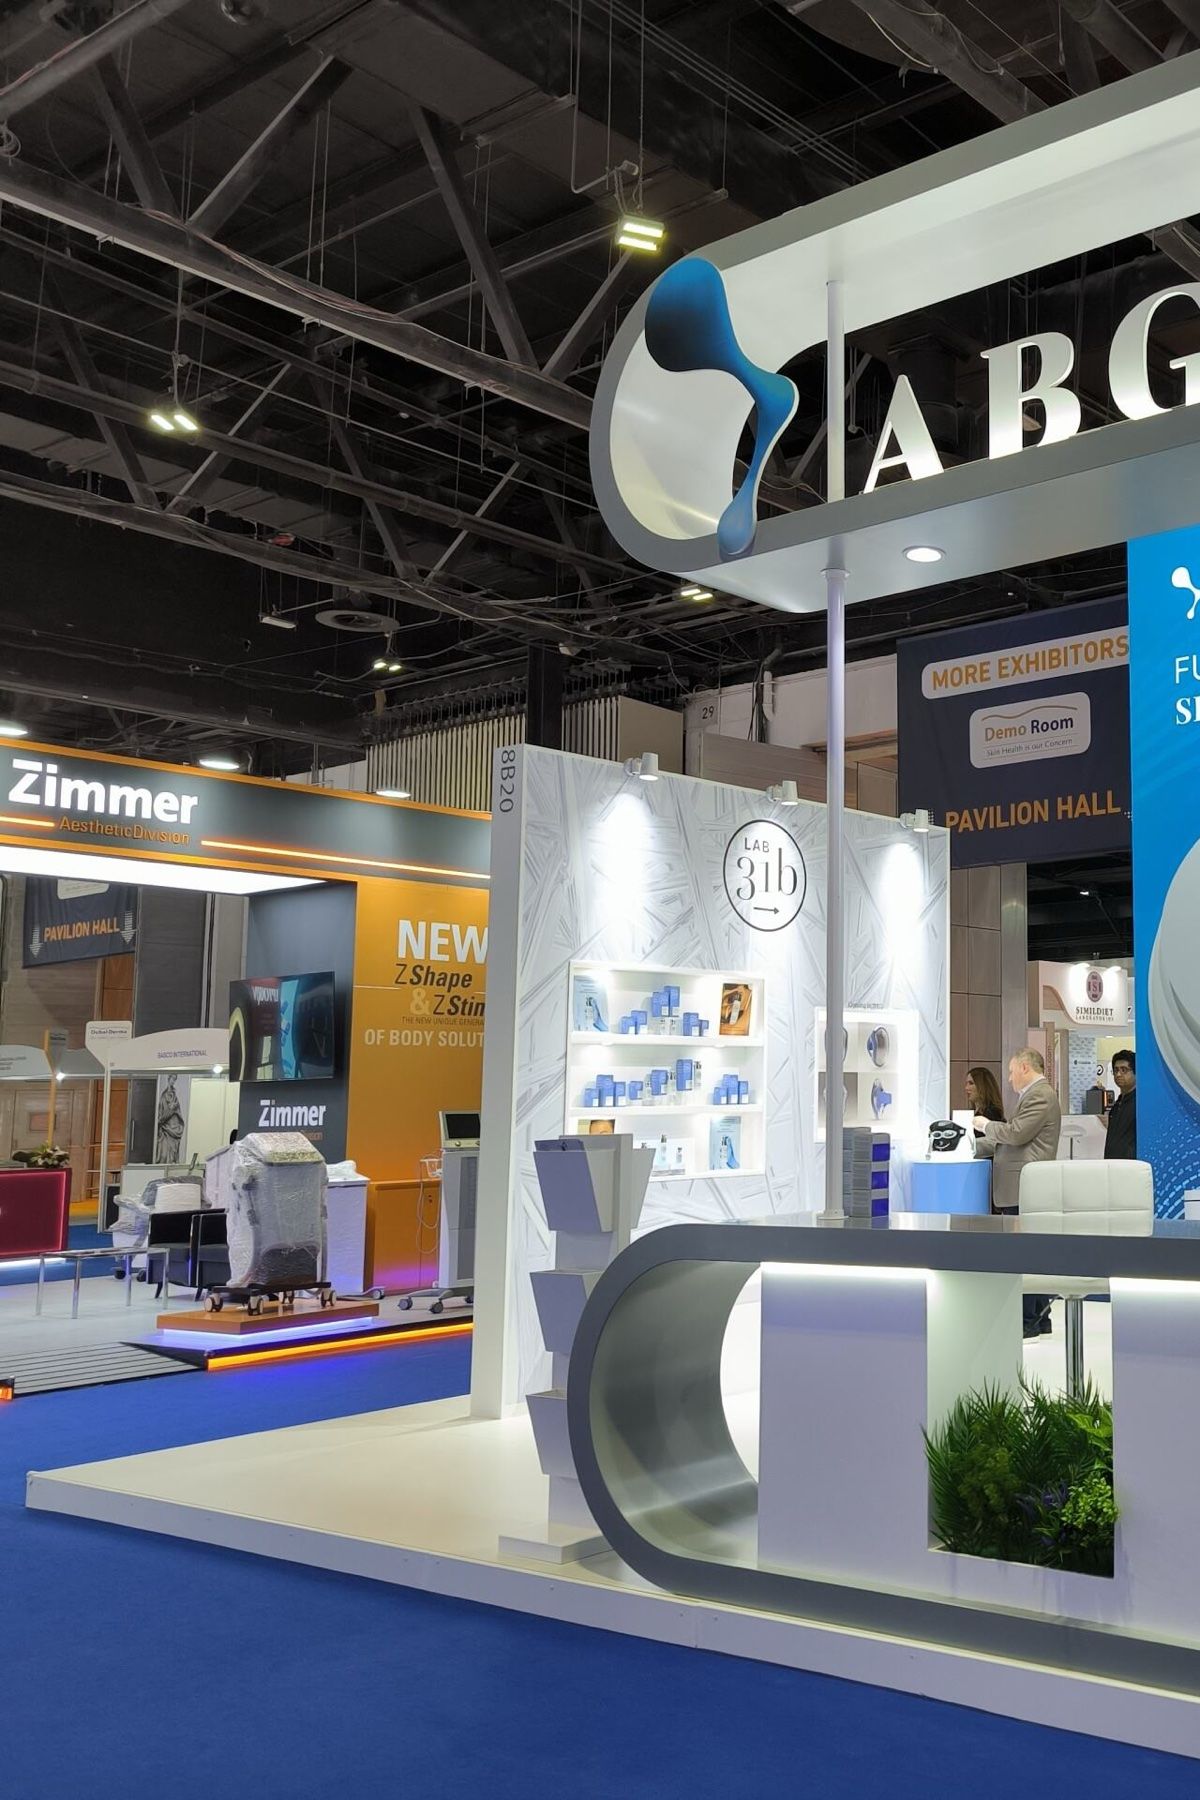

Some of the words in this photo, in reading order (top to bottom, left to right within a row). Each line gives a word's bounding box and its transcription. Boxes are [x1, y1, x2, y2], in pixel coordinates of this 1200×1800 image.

[932, 661, 991, 690] MORE
[997, 634, 1129, 679] EXHIBITORS
[702, 705, 714, 719] 29
[984, 725, 1027, 742] Demo
[1030, 715, 1074, 734] Room
[1001, 745, 1024, 755] Health
[1044, 738, 1073, 749] Concern
[8, 758, 200, 824] Zimmer
[500, 750, 516, 813] 8B20
[945, 798, 1049, 833] PAVILION
[1057, 790, 1121, 820] HALL
[744, 837, 770, 853] LAB
[44, 921, 90, 942] PAVILION
[92, 917, 120, 935] HALL
[398, 919, 488, 964] NEW
[410, 987, 430, 1015] &
[1075, 1006, 1114, 1016] SIMILDIET
[364, 1029, 385, 1045] OF
[389, 1030, 435, 1046] BODY
[438, 1031, 485, 1047] SOLUT
[258, 1099, 327, 1127] Zimmer
